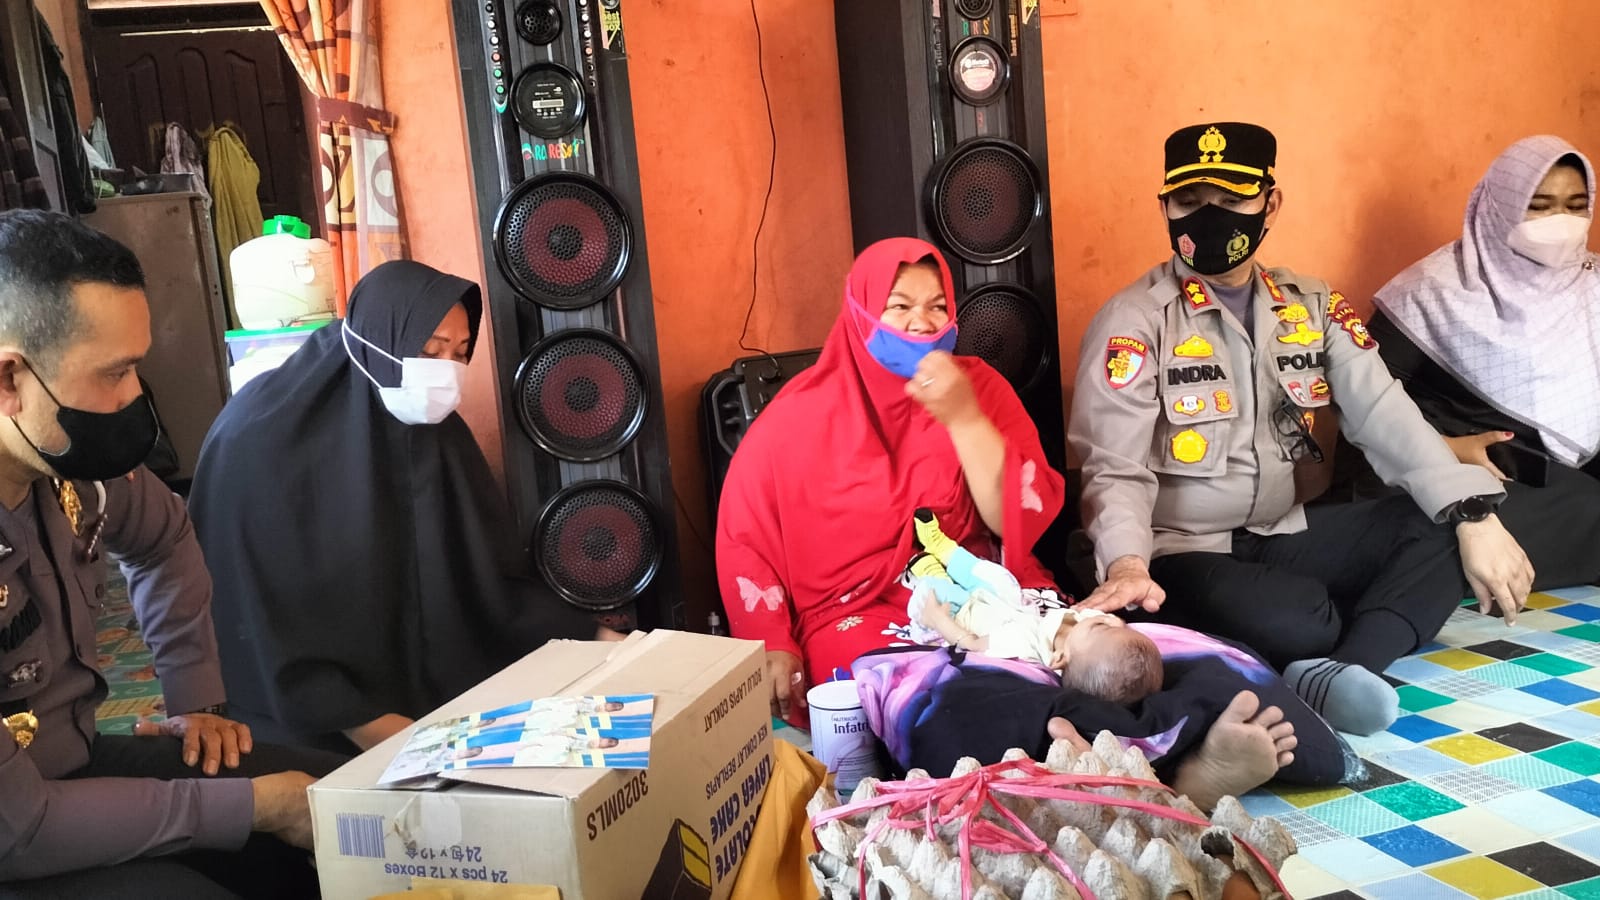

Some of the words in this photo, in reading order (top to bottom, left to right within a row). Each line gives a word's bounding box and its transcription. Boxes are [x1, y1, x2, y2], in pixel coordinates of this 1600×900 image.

[1111, 338, 1145, 352] PROPAM
[1167, 364, 1227, 386] INDRA
[729, 681, 748, 710] LAPIS
[704, 698, 729, 733] COKLAT
[757, 722, 768, 742] KEK
[737, 734, 758, 769] COKLAT
[706, 757, 737, 800] BERLAPIS
[741, 753, 772, 807] LAYER
[586, 769, 649, 841] 3020MLS
[710, 792, 740, 845] CAKE
[384, 863, 426, 877] Boxes
[430, 866, 446, 879] 12
[462, 865, 487, 880] pcs
[491, 870, 508, 884] 24
